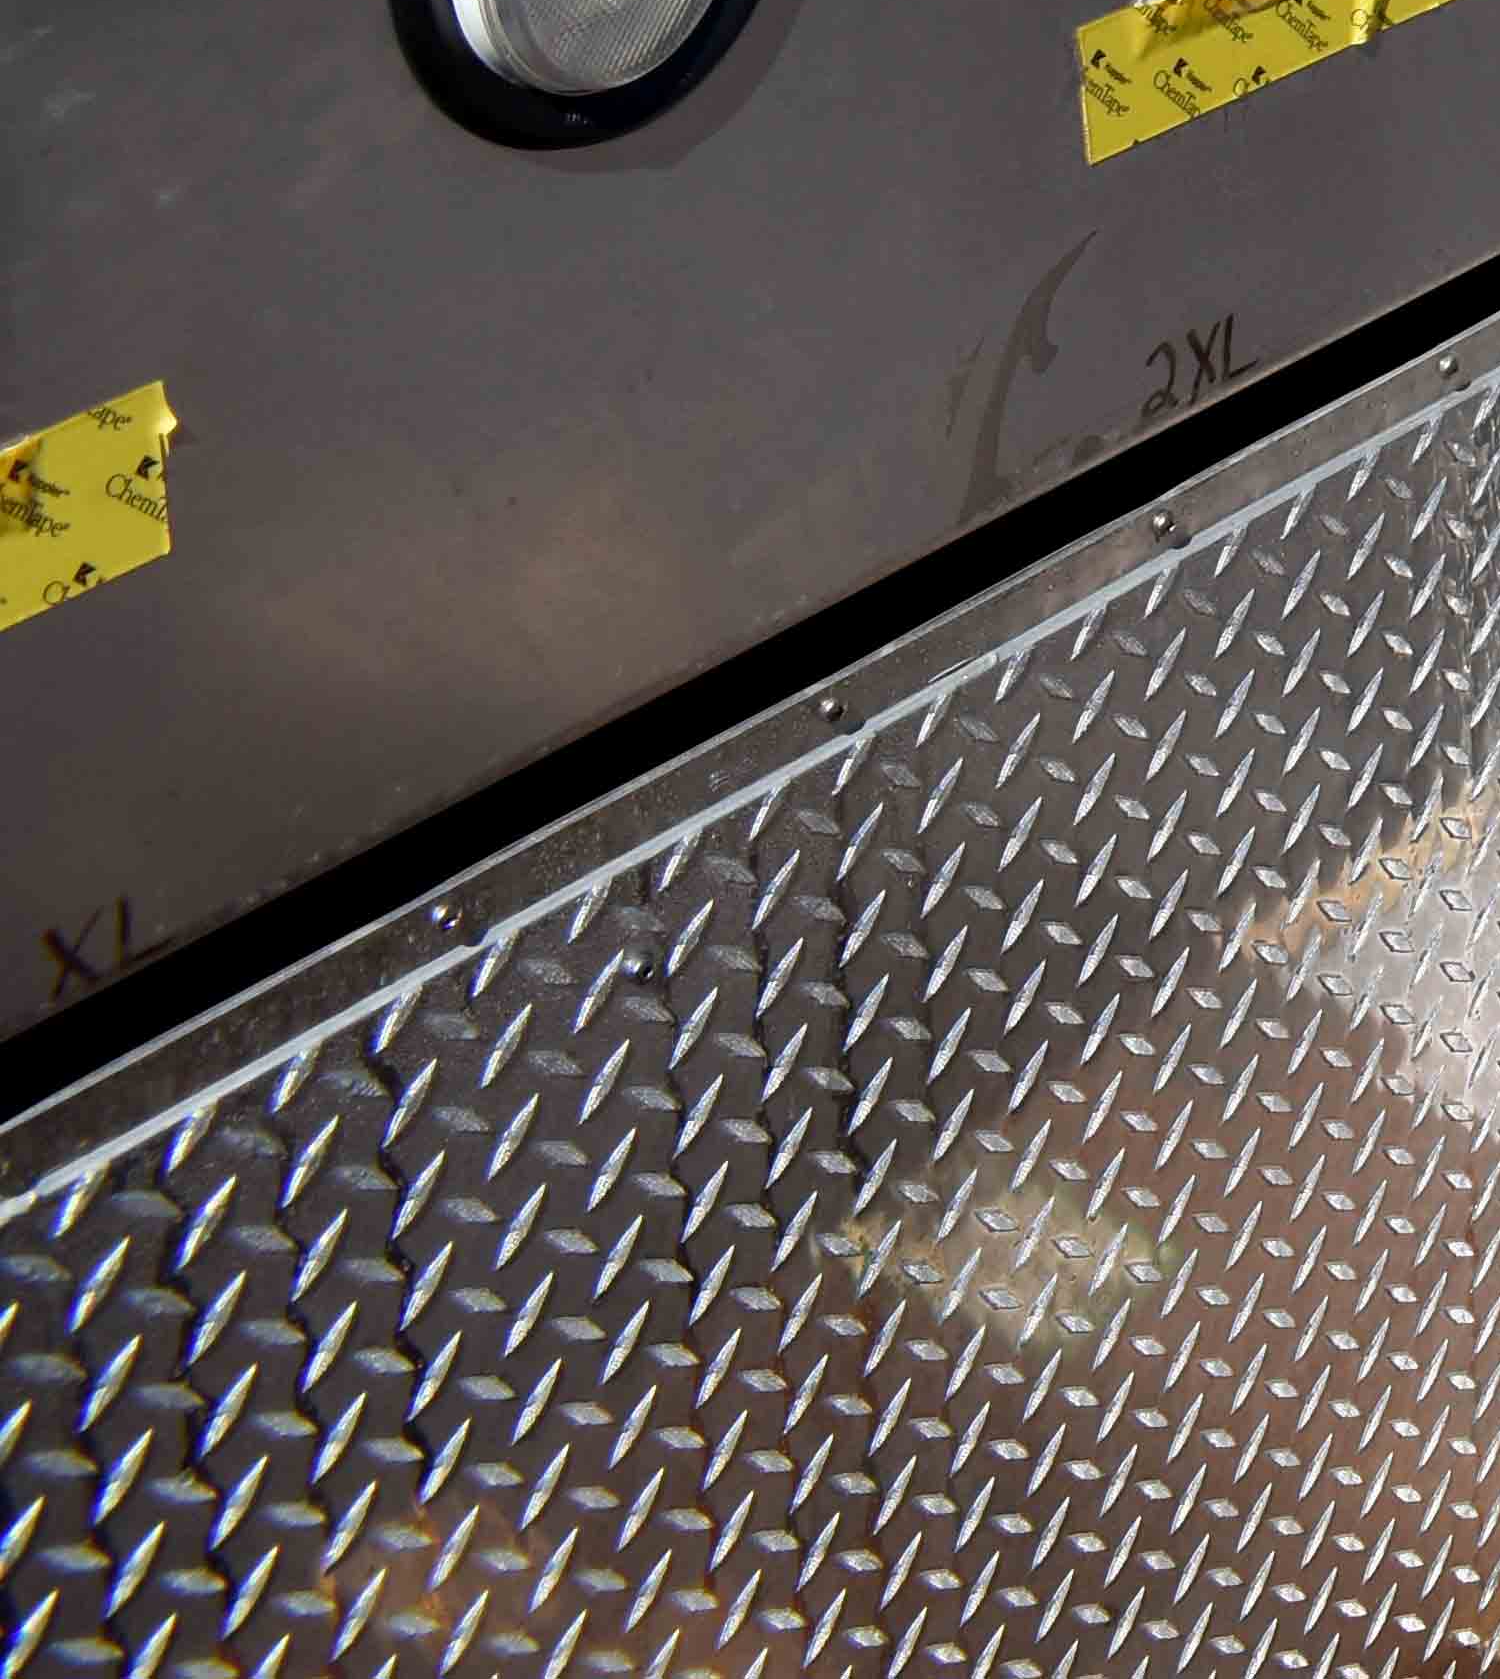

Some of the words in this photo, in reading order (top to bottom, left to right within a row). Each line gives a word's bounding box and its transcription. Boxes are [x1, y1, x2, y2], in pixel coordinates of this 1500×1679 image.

[1085, 79, 1131, 118] emTape
[1153, 69, 1201, 118] ChemTap
[1141, 312, 1258, 420] 2XL
[105, 473, 167, 522] ChemT
[40, 895, 174, 1000] XL
